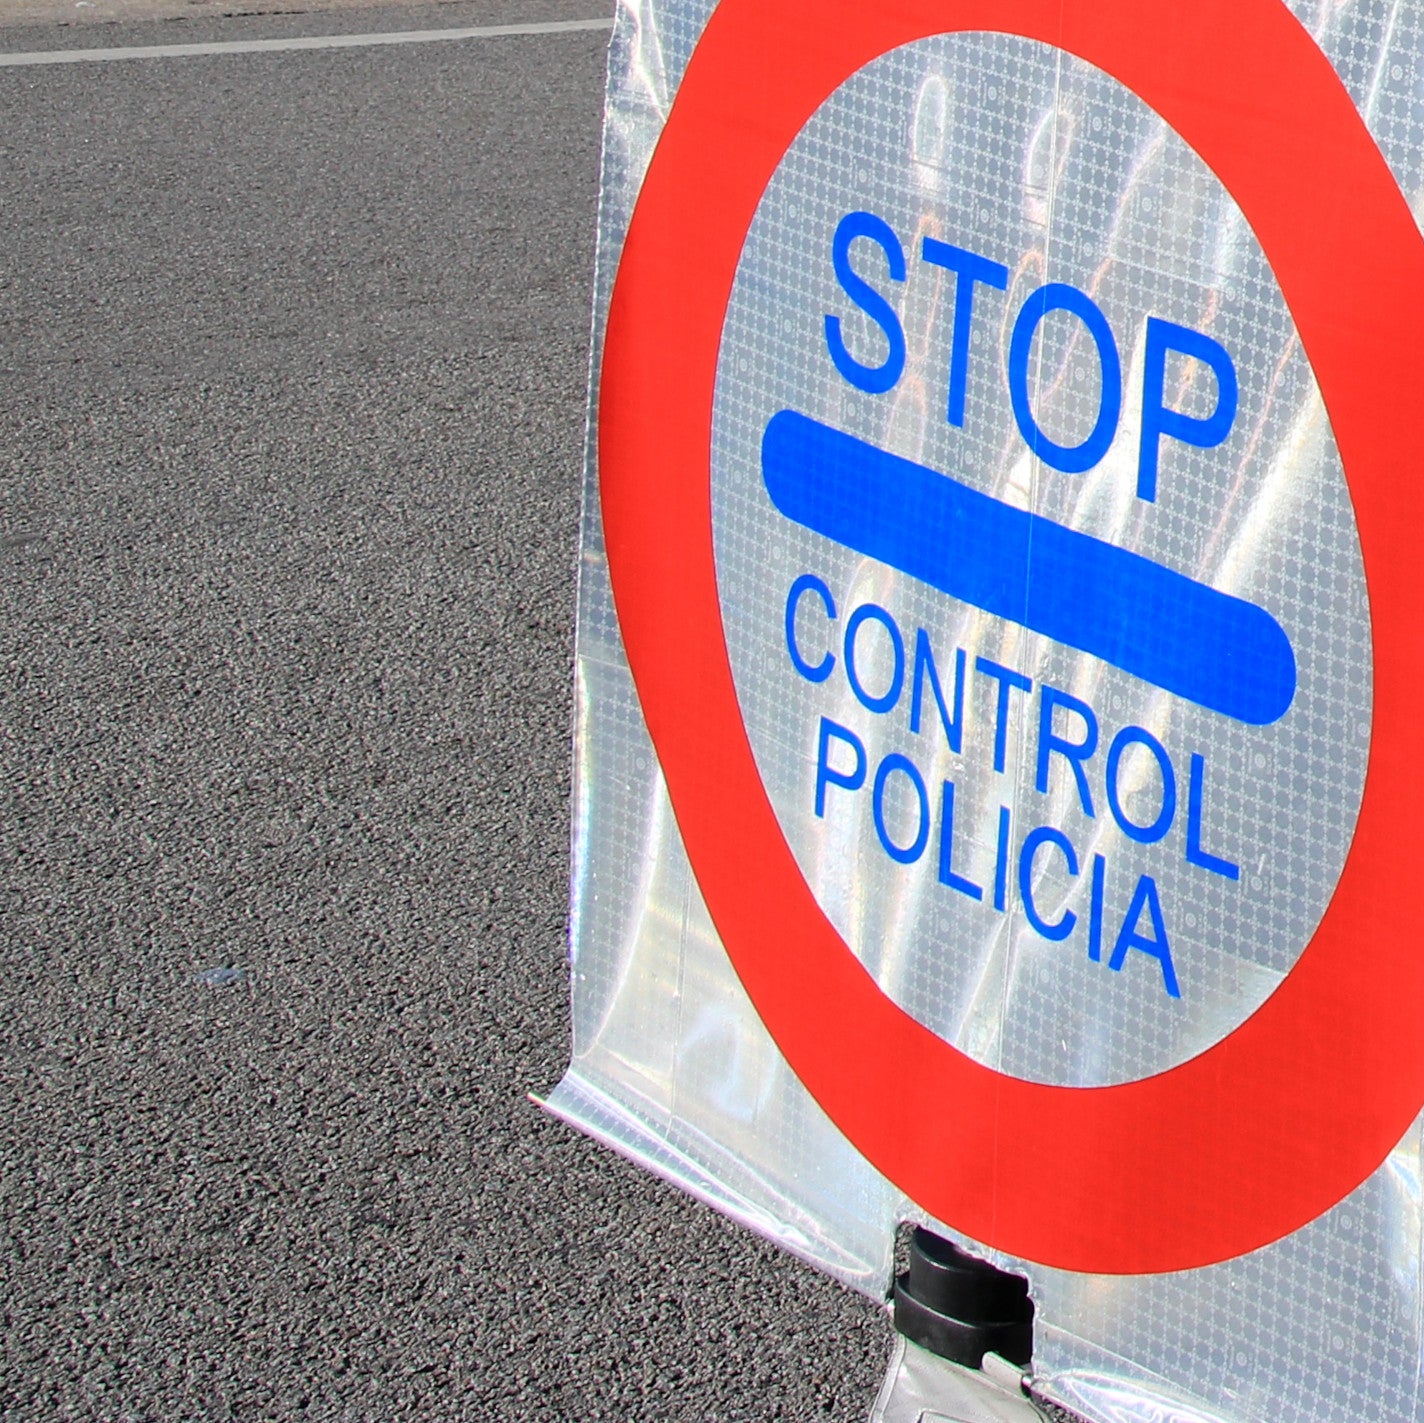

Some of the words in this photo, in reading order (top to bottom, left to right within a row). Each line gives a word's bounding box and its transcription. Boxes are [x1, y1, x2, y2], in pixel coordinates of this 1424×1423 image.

[825, 212, 1238, 503] STOP
[785, 574, 1239, 881] CONTROL
[815, 718, 1180, 998] POLICIA
